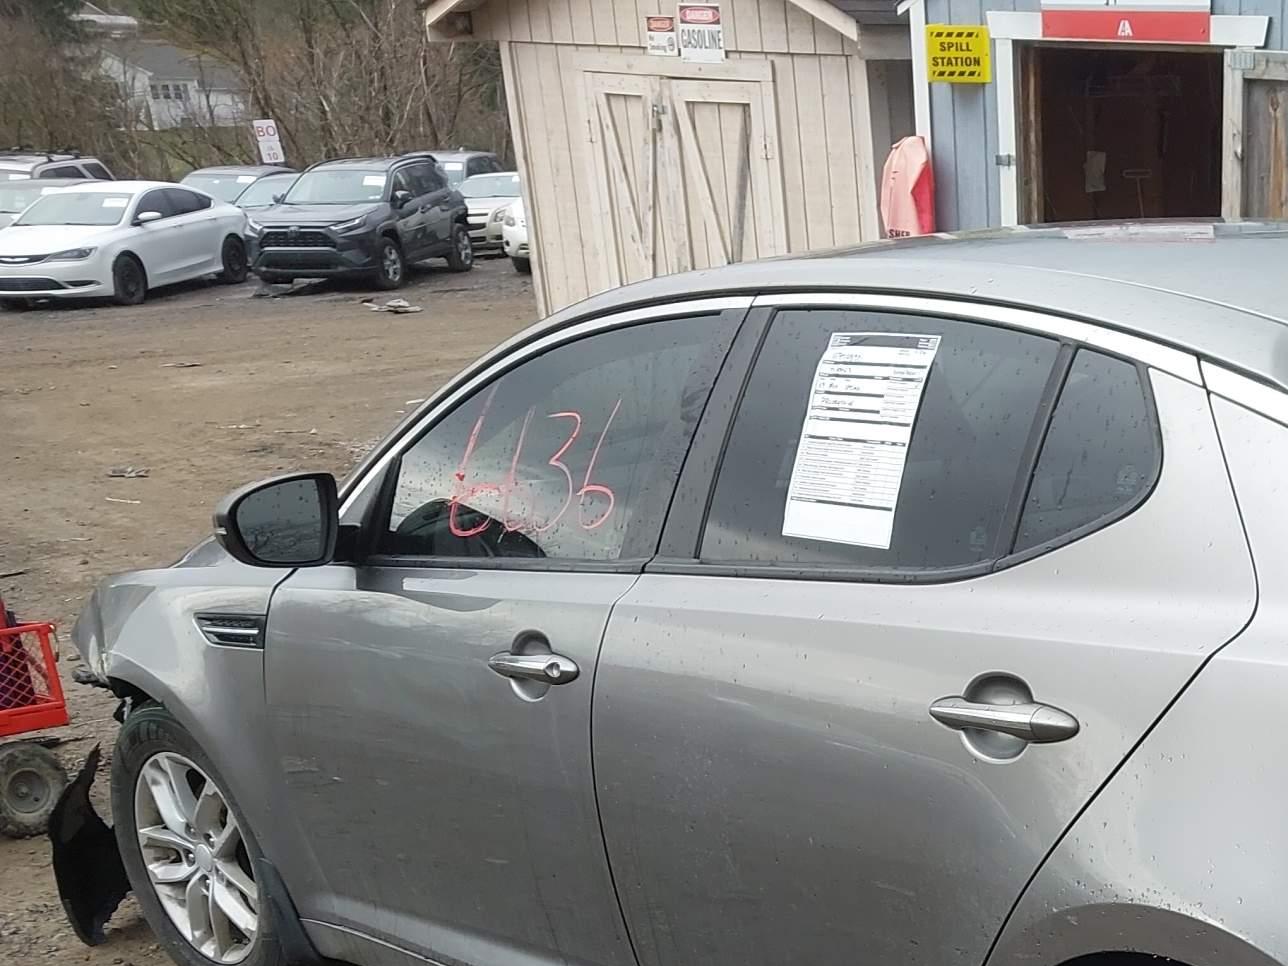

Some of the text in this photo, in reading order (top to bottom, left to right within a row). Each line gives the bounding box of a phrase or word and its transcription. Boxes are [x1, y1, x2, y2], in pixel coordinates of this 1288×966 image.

[681, 28, 722, 49] GASOLINE
[939, 41, 973, 52] SPILL
[932, 56, 981, 67] STATION
